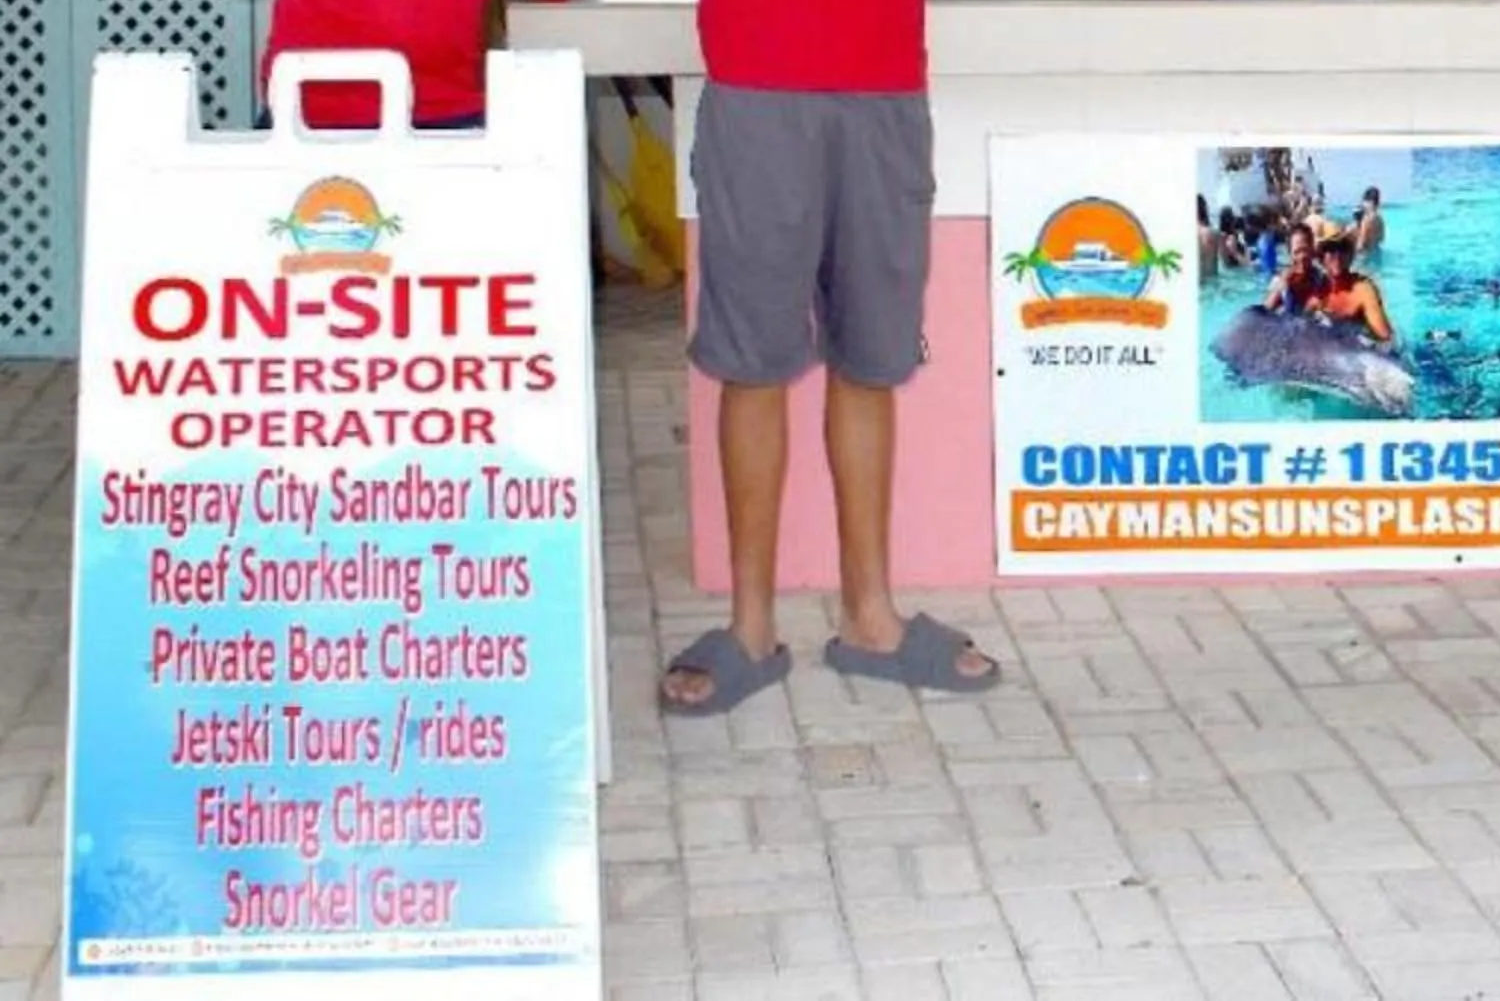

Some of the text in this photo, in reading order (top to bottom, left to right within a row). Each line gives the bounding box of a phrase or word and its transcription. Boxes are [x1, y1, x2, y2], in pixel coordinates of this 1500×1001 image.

[132, 274, 537, 342] ON-SITE
[114, 354, 557, 396] WATERSPORTS
[171, 407, 497, 450] OPERATOR
[1022, 443, 1272, 485] CONTACT
[1285, 446, 1327, 483] #
[102, 465, 577, 537] Stingray City Sandbar Tours
[150, 543, 530, 612] Reef Snorkeling Tours
[152, 626, 528, 683] Private Boat Charters
[171, 697, 505, 772] Jetski Tours / rides
[196, 785, 482, 858] Fishing Charters
[224, 867, 456, 929] Snorkel Gear
